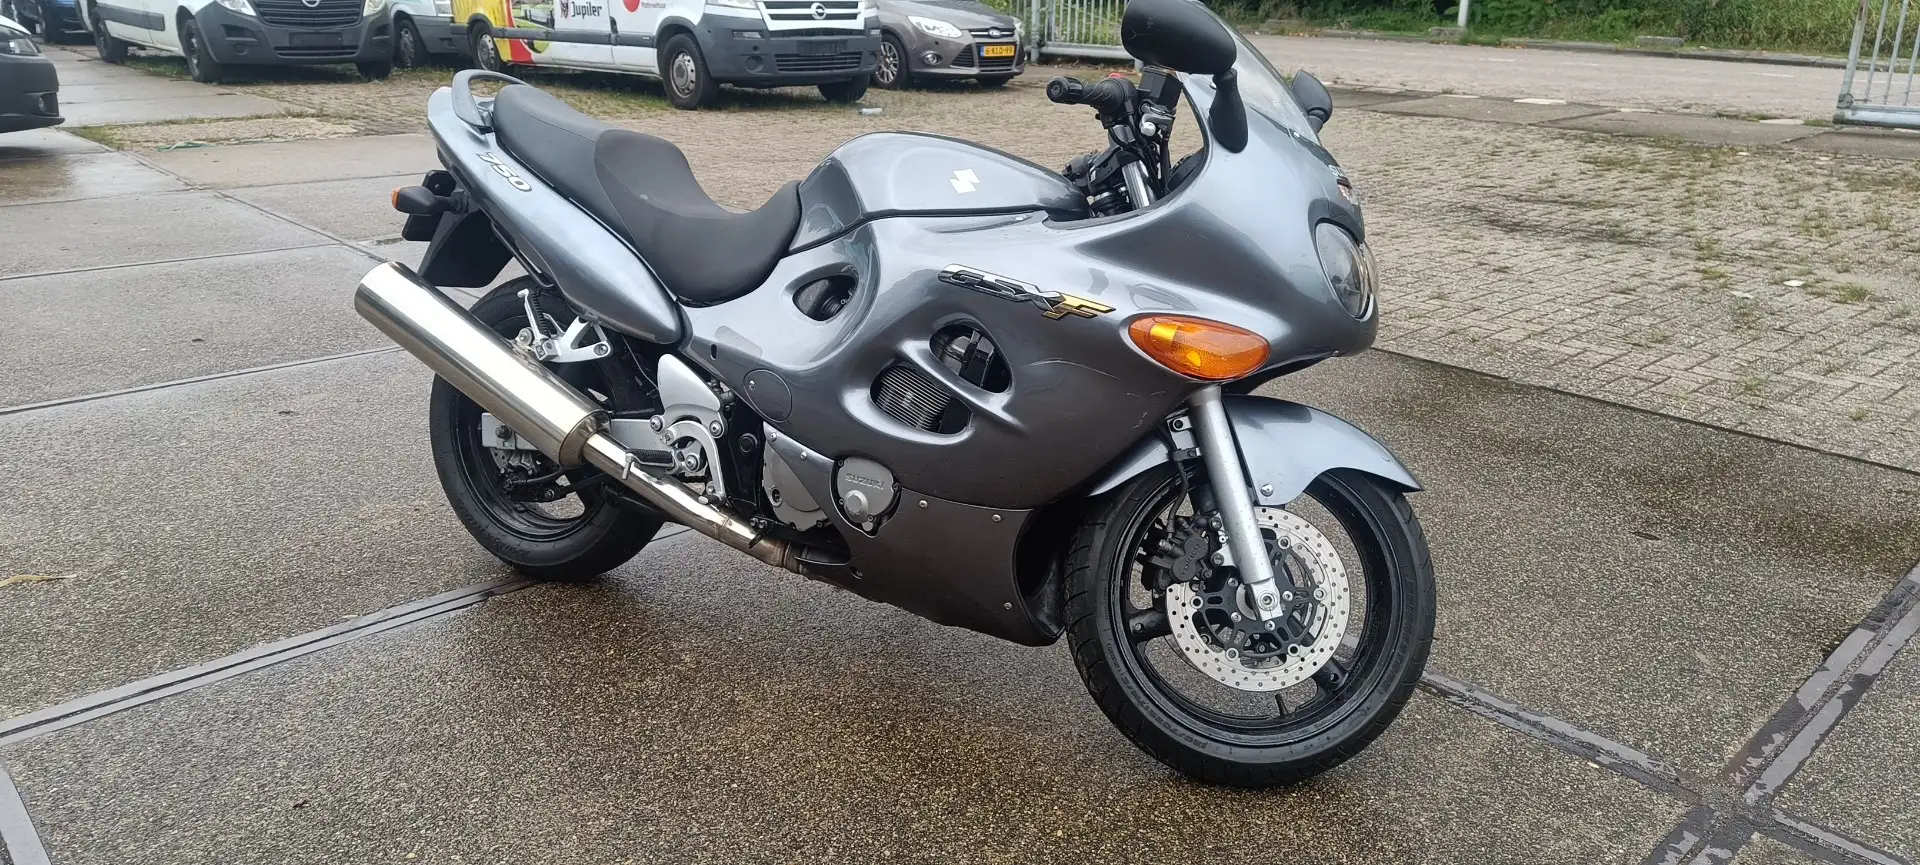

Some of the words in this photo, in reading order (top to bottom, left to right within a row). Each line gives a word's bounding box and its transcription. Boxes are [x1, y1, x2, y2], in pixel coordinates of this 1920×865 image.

[570, 1, 602, 19] Jupiler
[476, 151, 533, 192] 750
[844, 473, 885, 490] SUZUKI
